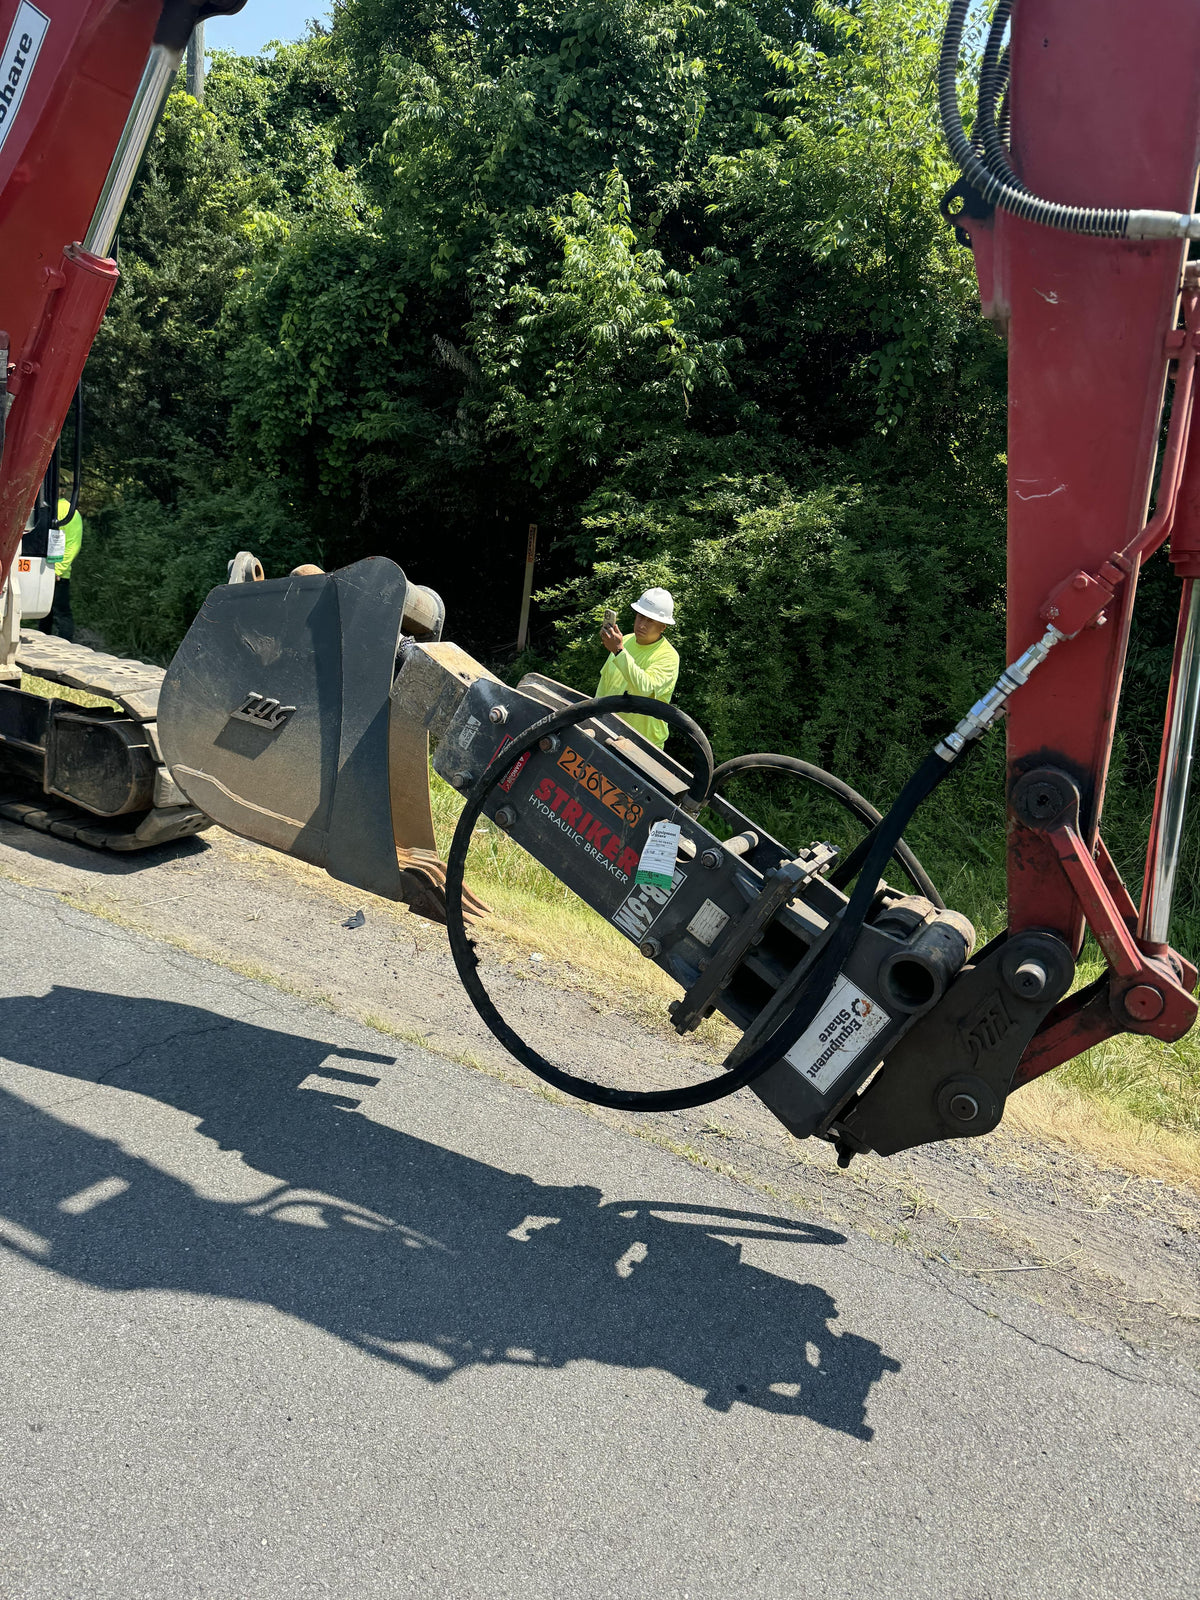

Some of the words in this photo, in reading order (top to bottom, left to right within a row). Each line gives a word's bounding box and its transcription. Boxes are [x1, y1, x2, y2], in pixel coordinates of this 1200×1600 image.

[559, 750, 641, 824] 256728
[528, 794, 584, 847] HYDRAULIC
[583, 842, 629, 885] BREAKER
[534, 778, 640, 877] STRIKER
[806, 1018, 863, 1078] Equipment
[818, 1008, 852, 1043] Share
